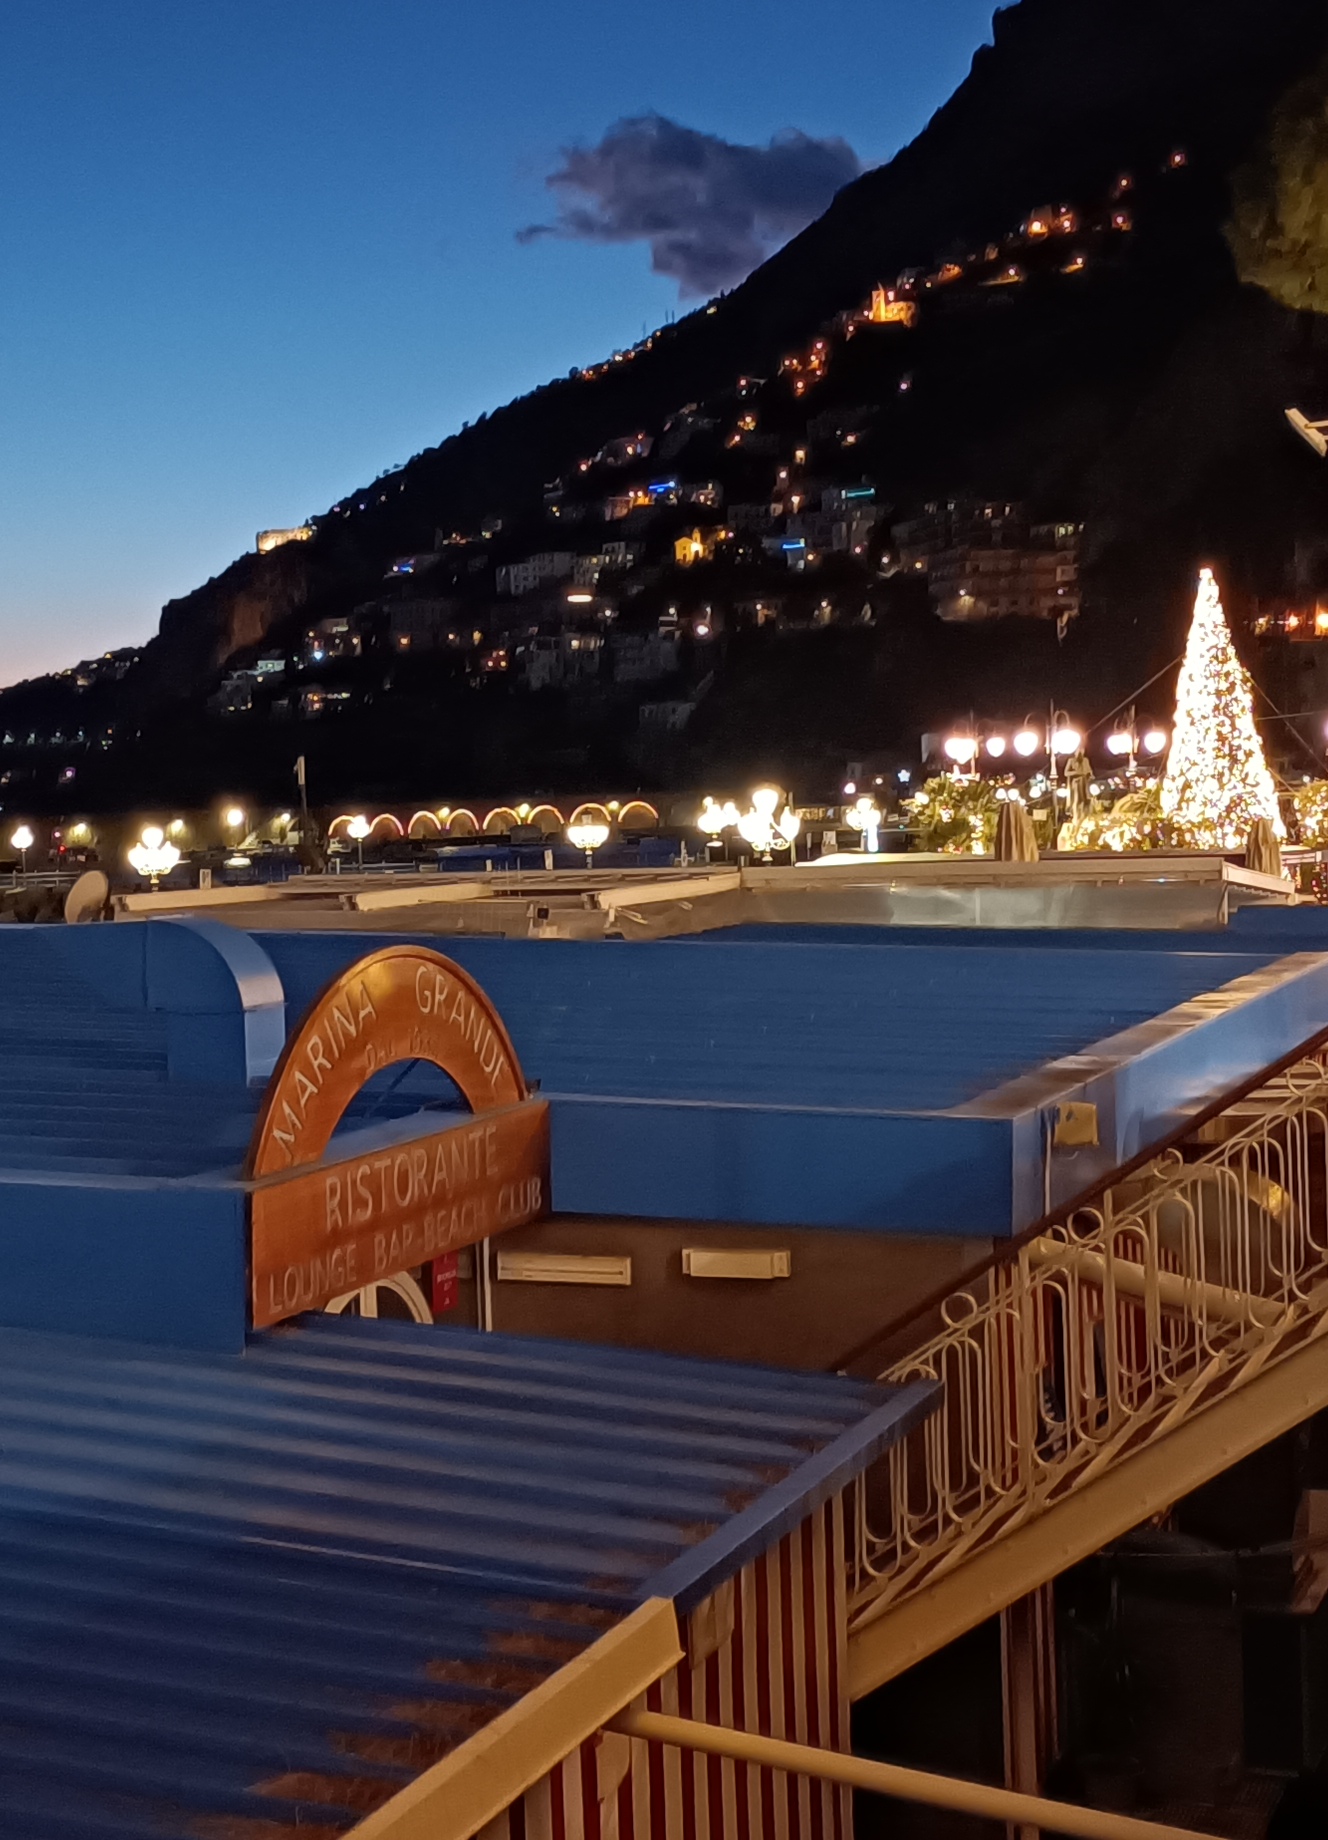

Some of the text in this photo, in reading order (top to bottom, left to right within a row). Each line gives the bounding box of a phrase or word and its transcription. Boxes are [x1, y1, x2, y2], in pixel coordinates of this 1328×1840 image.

[272, 965, 512, 1163] MARINA GRANDE
[268, 1242, 358, 1314] LOUNGE
[496, 1177, 543, 1225] CLUB
[325, 1125, 499, 1233] RISTORANTE
